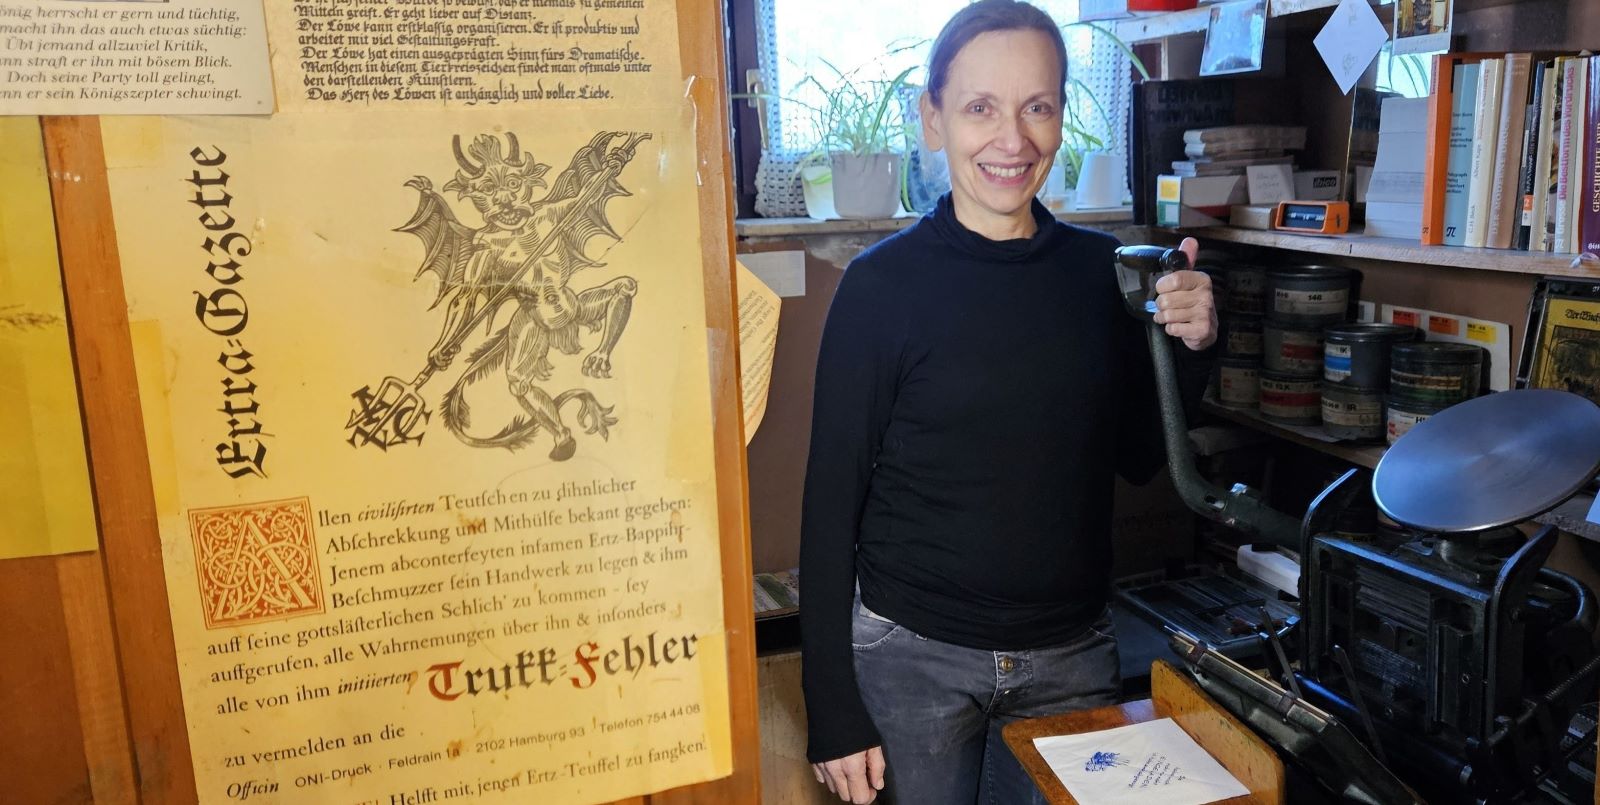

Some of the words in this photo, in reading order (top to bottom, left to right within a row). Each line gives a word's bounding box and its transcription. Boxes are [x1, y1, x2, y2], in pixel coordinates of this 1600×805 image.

[594, 0, 645, 10] gemeinen
[37, 7, 98, 19] herrscht
[103, 10, 117, 19] er
[120, 10, 153, 21] gern
[158, 8, 184, 19] und
[189, 8, 240, 22] tüchtig,
[402, 8, 425, 21] geht
[430, 9, 459, 19] lieber
[463, 9, 482, 21] auf
[51, 24, 75, 34] ihn
[80, 24, 105, 35] das
[110, 24, 145, 35] auch
[149, 26, 189, 35] etwas
[193, 25, 247, 38] süchtig:
[298, 18, 324, 31] Der
[363, 22, 393, 32] kann
[620, 14, 640, 35] und
[7, 36, 33, 50] Übt
[38, 40, 94, 52] jemand
[98, 40, 160, 51] allzuviel
[164, 40, 208, 52] Kritik,
[298, 35, 345, 46] arbeitet
[348, 37, 369, 46] mit
[372, 36, 393, 46] viel
[301, 46, 328, 60] Der
[368, 48, 388, 62] hat
[390, 50, 420, 60] einen
[507, 42, 538, 60] Sinn
[27, 56, 67, 69] straft
[72, 58, 87, 67] er
[91, 56, 114, 67] ihn
[119, 56, 142, 67] mit
[146, 56, 190, 67] bösem
[195, 56, 232, 67] Blick.
[365, 63, 378, 73] in
[518, 63, 549, 76] findet
[551, 64, 576, 73] man
[579, 62, 621, 76] oftmals
[624, 62, 652, 73] unter
[8, 71, 46, 83] Doch
[51, 72, 88, 83] seine
[92, 71, 132, 85] Party
[136, 72, 159, 83] toll
[163, 72, 215, 85] gelingt,
[304, 76, 324, 86] den
[27, 90, 42, 99] er
[46, 88, 74, 99] sein
[80, 87, 173, 101] Königszepter
[176, 88, 242, 101] schwingt.
[307, 88, 337, 100] Das
[373, 89, 389, 100] des
[522, 79, 543, 100] und
[546, 81, 575, 99] voller
[577, 85, 614, 99] Liebe.
[533, 489, 550, 500] zu
[456, 521, 487, 537] und
[493, 510, 563, 532] Mithülfe
[568, 506, 620, 523] bekant
[625, 497, 692, 522] gegeben:
[329, 561, 385, 587] Jenem
[391, 544, 515, 572] abconterfeyten
[521, 538, 584, 555] infamen
[486, 560, 571, 585] Handwerk
[576, 563, 594, 575] zu
[599, 556, 638, 575] legen
[643, 551, 656, 565] &
[660, 546, 688, 562] ihm
[208, 637, 241, 656] auff
[512, 596, 531, 608] zu
[538, 588, 606, 606] kommen
[211, 654, 318, 685] auffgerufen,
[324, 648, 354, 666] alle
[358, 628, 495, 659] Wahrnemungen
[503, 621, 538, 636] über
[545, 615, 570, 631] ihn
[577, 613, 590, 626] &
[217, 697, 249, 715] alle
[255, 694, 289, 709] von
[296, 685, 330, 702] ihm
[337, 670, 413, 694] initiierten
[224, 755, 246, 768] zu
[252, 737, 346, 764] vermelden
[353, 731, 372, 746] an
[379, 723, 406, 741] die
[226, 778, 280, 801] Officin
[295, 763, 372, 788] ONI-Druck
[388, 751, 442, 769] Feldrain
[475, 740, 505, 753] 2102
[509, 732, 566, 748] Hamburg
[569, 727, 585, 738] 93
[600, 718, 643, 734] Telefon
[647, 710, 667, 724] 754
[669, 706, 683, 718] 44
[685, 703, 701, 716] 08
[444, 780, 474, 799] mit,
[478, 776, 520, 797] jenen
[626, 756, 642, 768] zu
